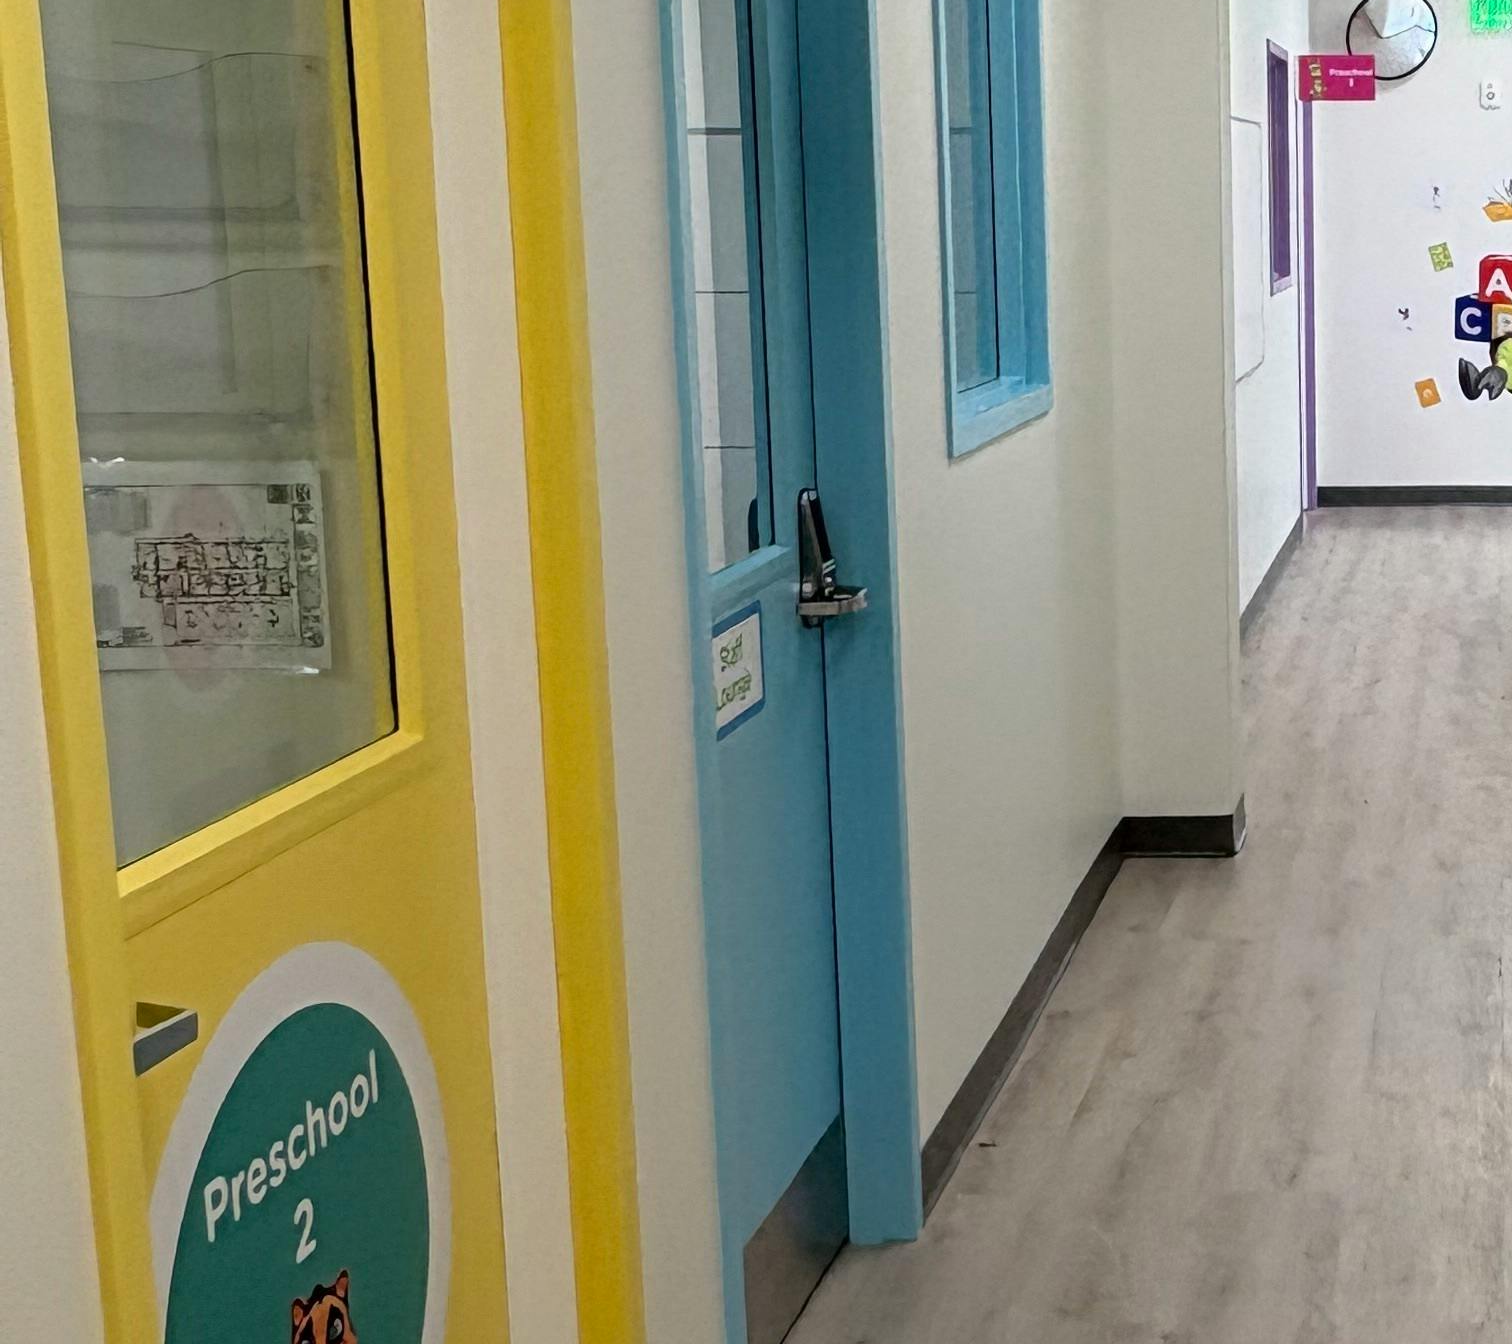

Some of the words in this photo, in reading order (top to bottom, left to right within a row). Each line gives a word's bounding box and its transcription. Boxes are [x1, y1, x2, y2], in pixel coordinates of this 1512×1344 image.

[1459, 307, 1483, 336] C
[203, 1048, 379, 1243] Preschool
[294, 1198, 317, 1264] 2
